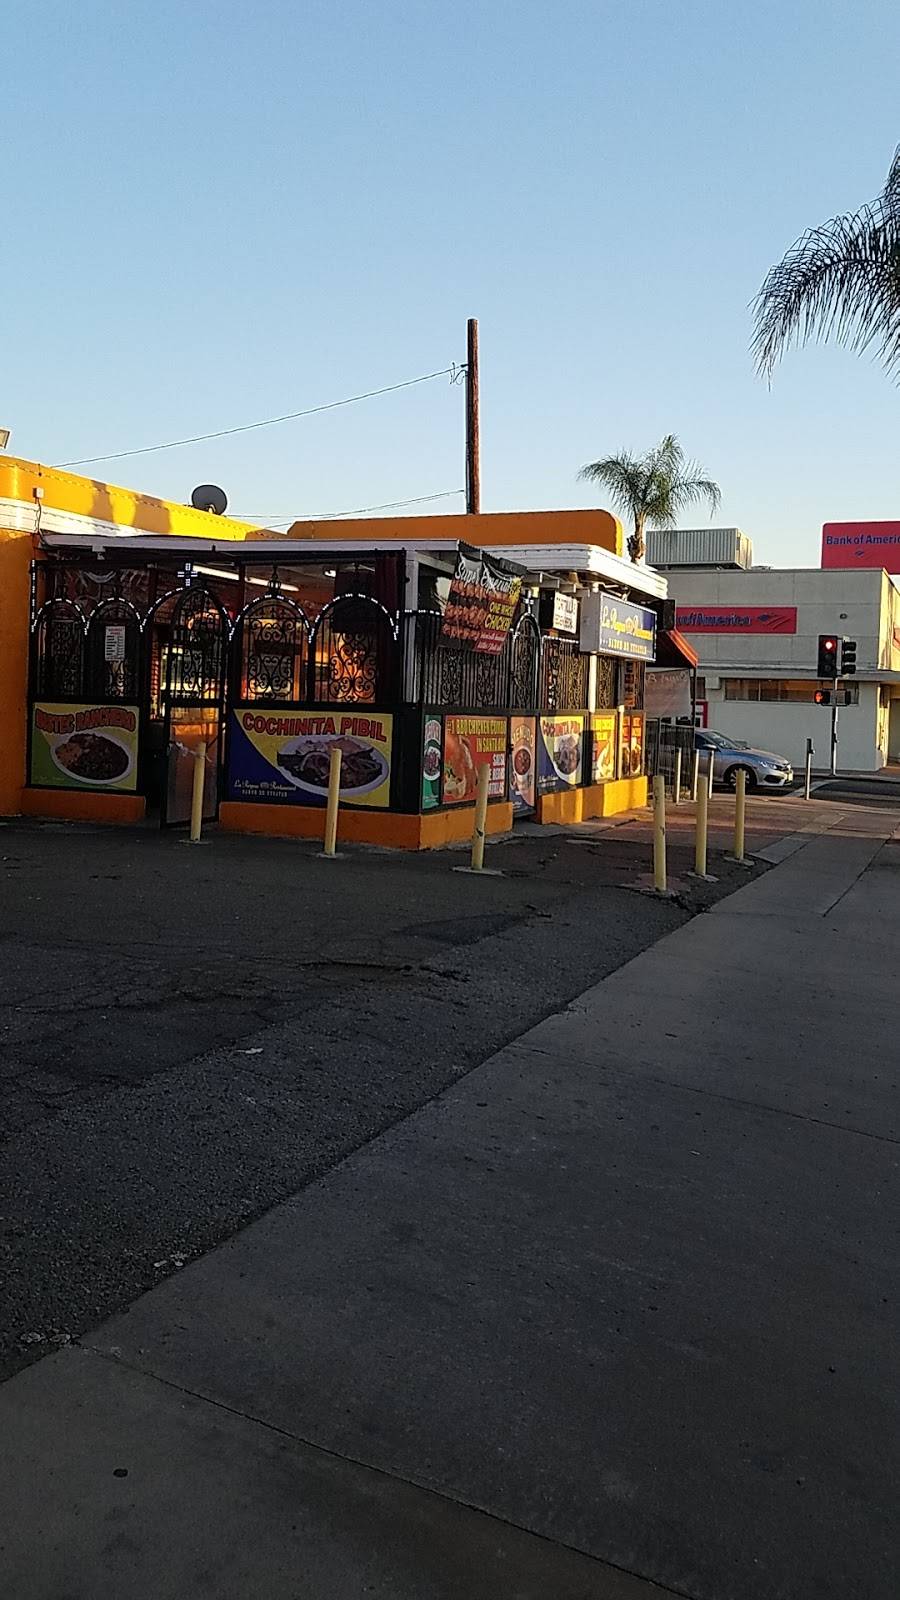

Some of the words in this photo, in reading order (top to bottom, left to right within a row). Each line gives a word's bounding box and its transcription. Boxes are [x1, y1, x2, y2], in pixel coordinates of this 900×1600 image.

[826, 535, 852, 545] Bank
[853, 534, 864, 545] of
[695, 612, 752, 626] America
[76, 707, 136, 732] RANCHERO
[242, 712, 336, 736] COCHINITA
[340, 717, 387, 742] PIBIL
